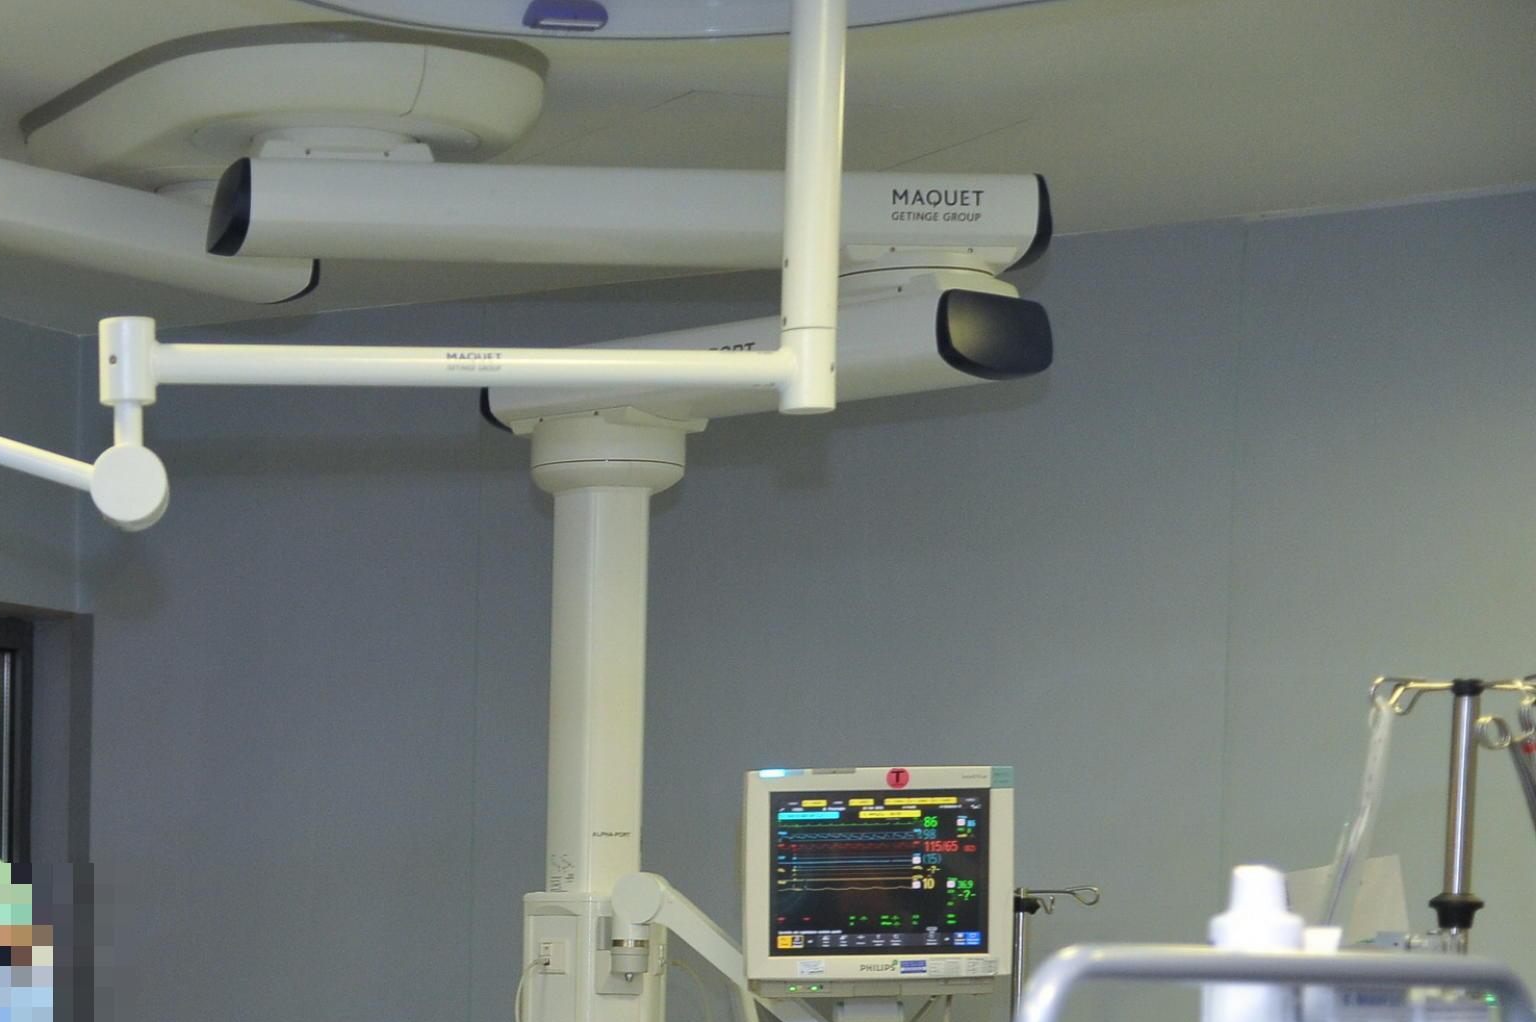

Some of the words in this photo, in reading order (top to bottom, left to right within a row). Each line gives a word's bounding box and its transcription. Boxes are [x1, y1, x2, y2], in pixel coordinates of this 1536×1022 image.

[892, 189, 985, 207] MAQUET
[891, 211, 939, 222] GETINGE
[942, 212, 983, 222] GROUP
[859, 963, 896, 972] PHILIPS
